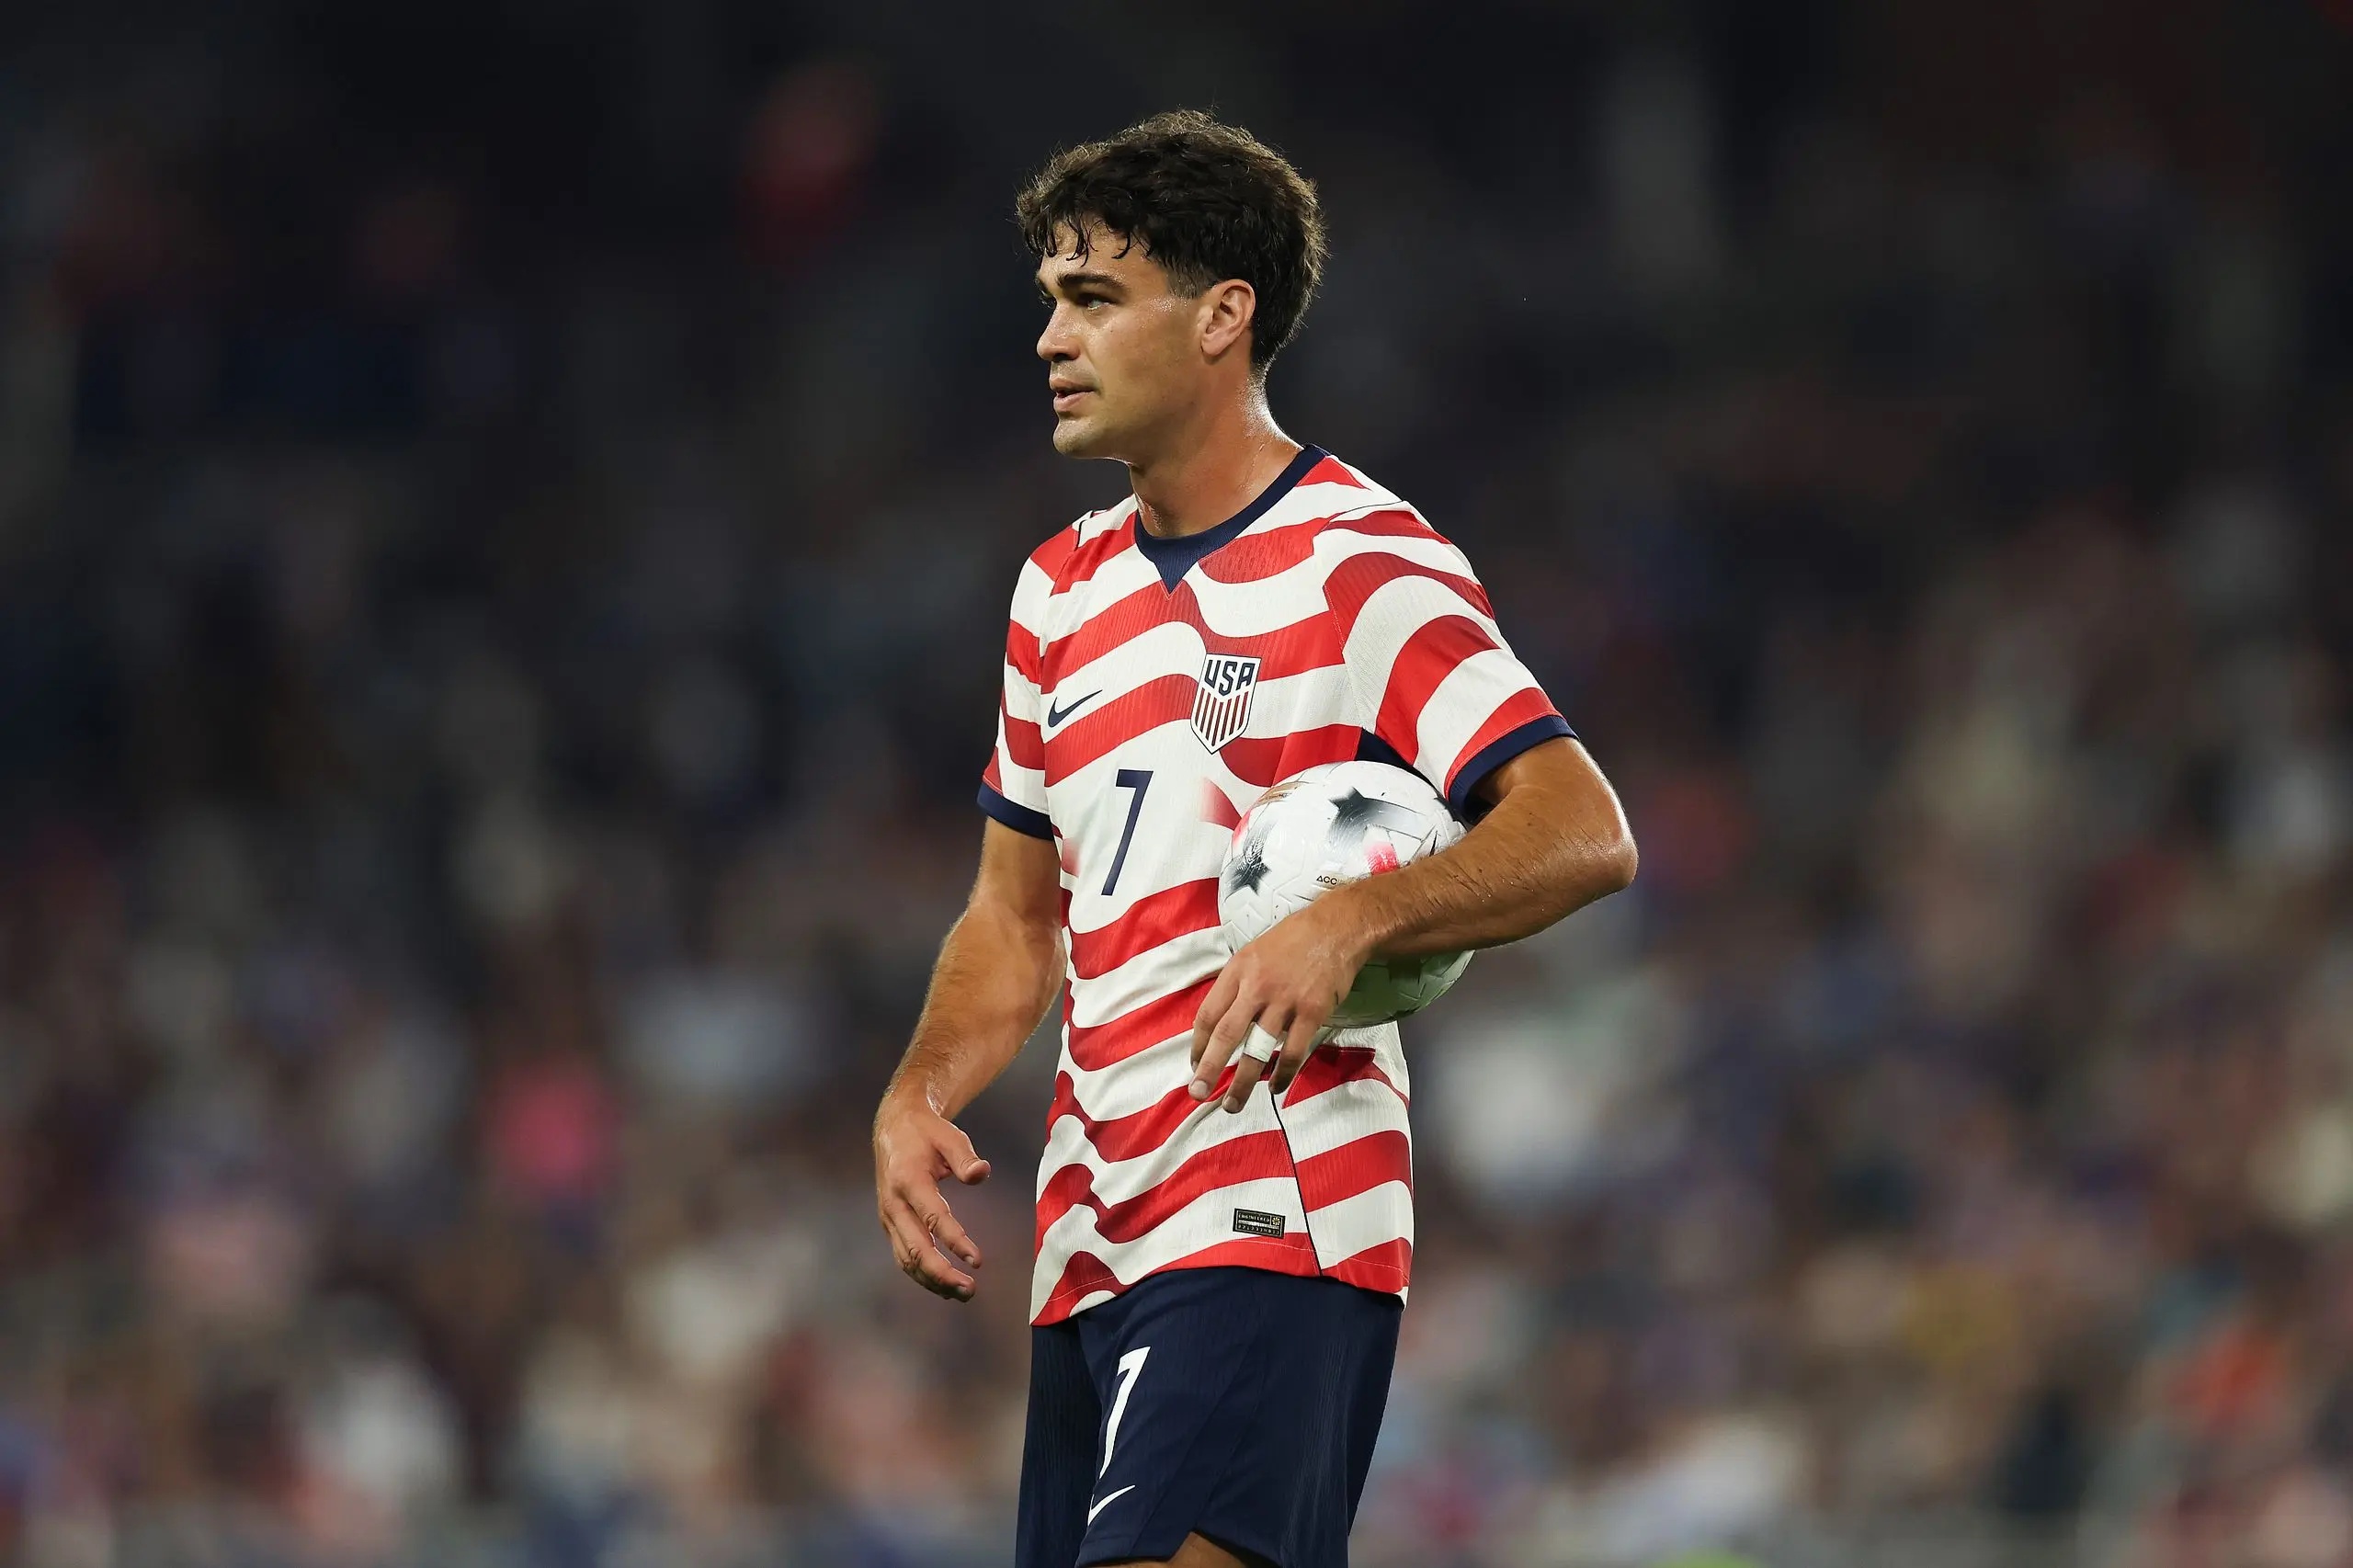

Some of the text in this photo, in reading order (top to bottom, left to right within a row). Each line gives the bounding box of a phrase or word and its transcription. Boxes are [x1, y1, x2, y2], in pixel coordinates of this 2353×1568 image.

[1204, 659, 1256, 696] USA
[1101, 769, 1154, 895] 7
[1098, 1346, 1152, 1479] 7
